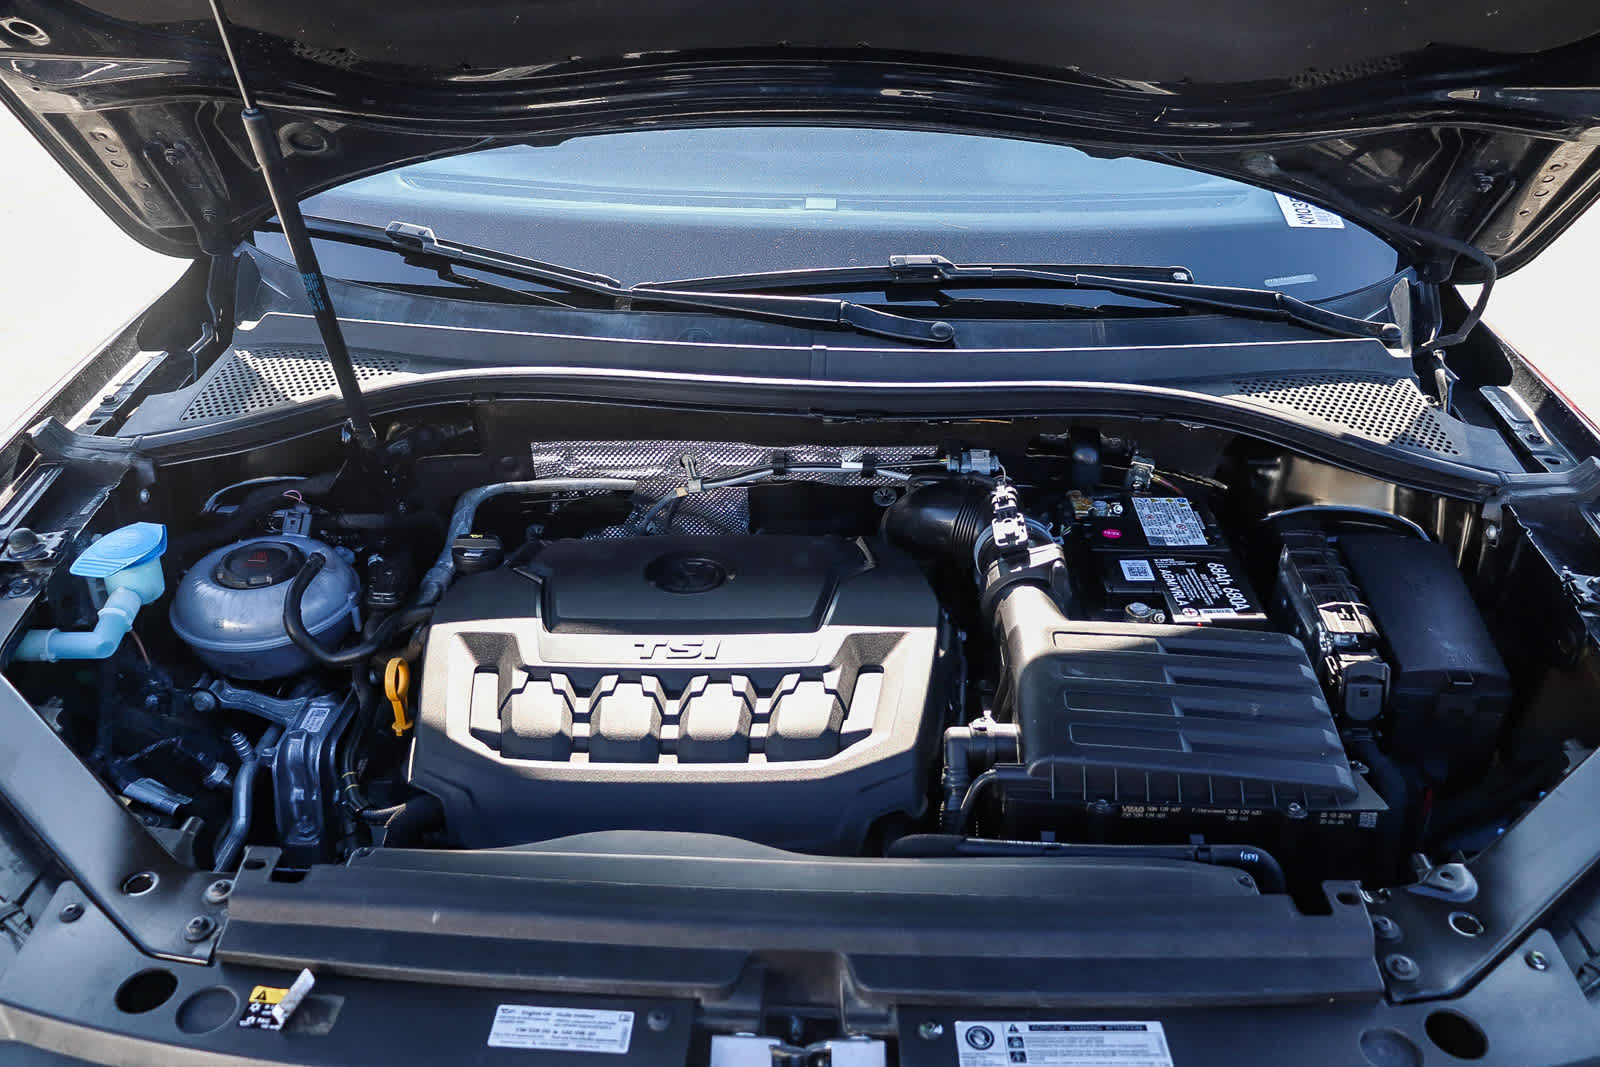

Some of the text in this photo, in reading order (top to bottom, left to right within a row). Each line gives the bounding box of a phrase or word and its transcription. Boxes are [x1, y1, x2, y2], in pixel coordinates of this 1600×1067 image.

[1207, 562, 1234, 586] 68Ah
[1222, 587, 1251, 611] 680A
[634, 639, 722, 660] TSI
